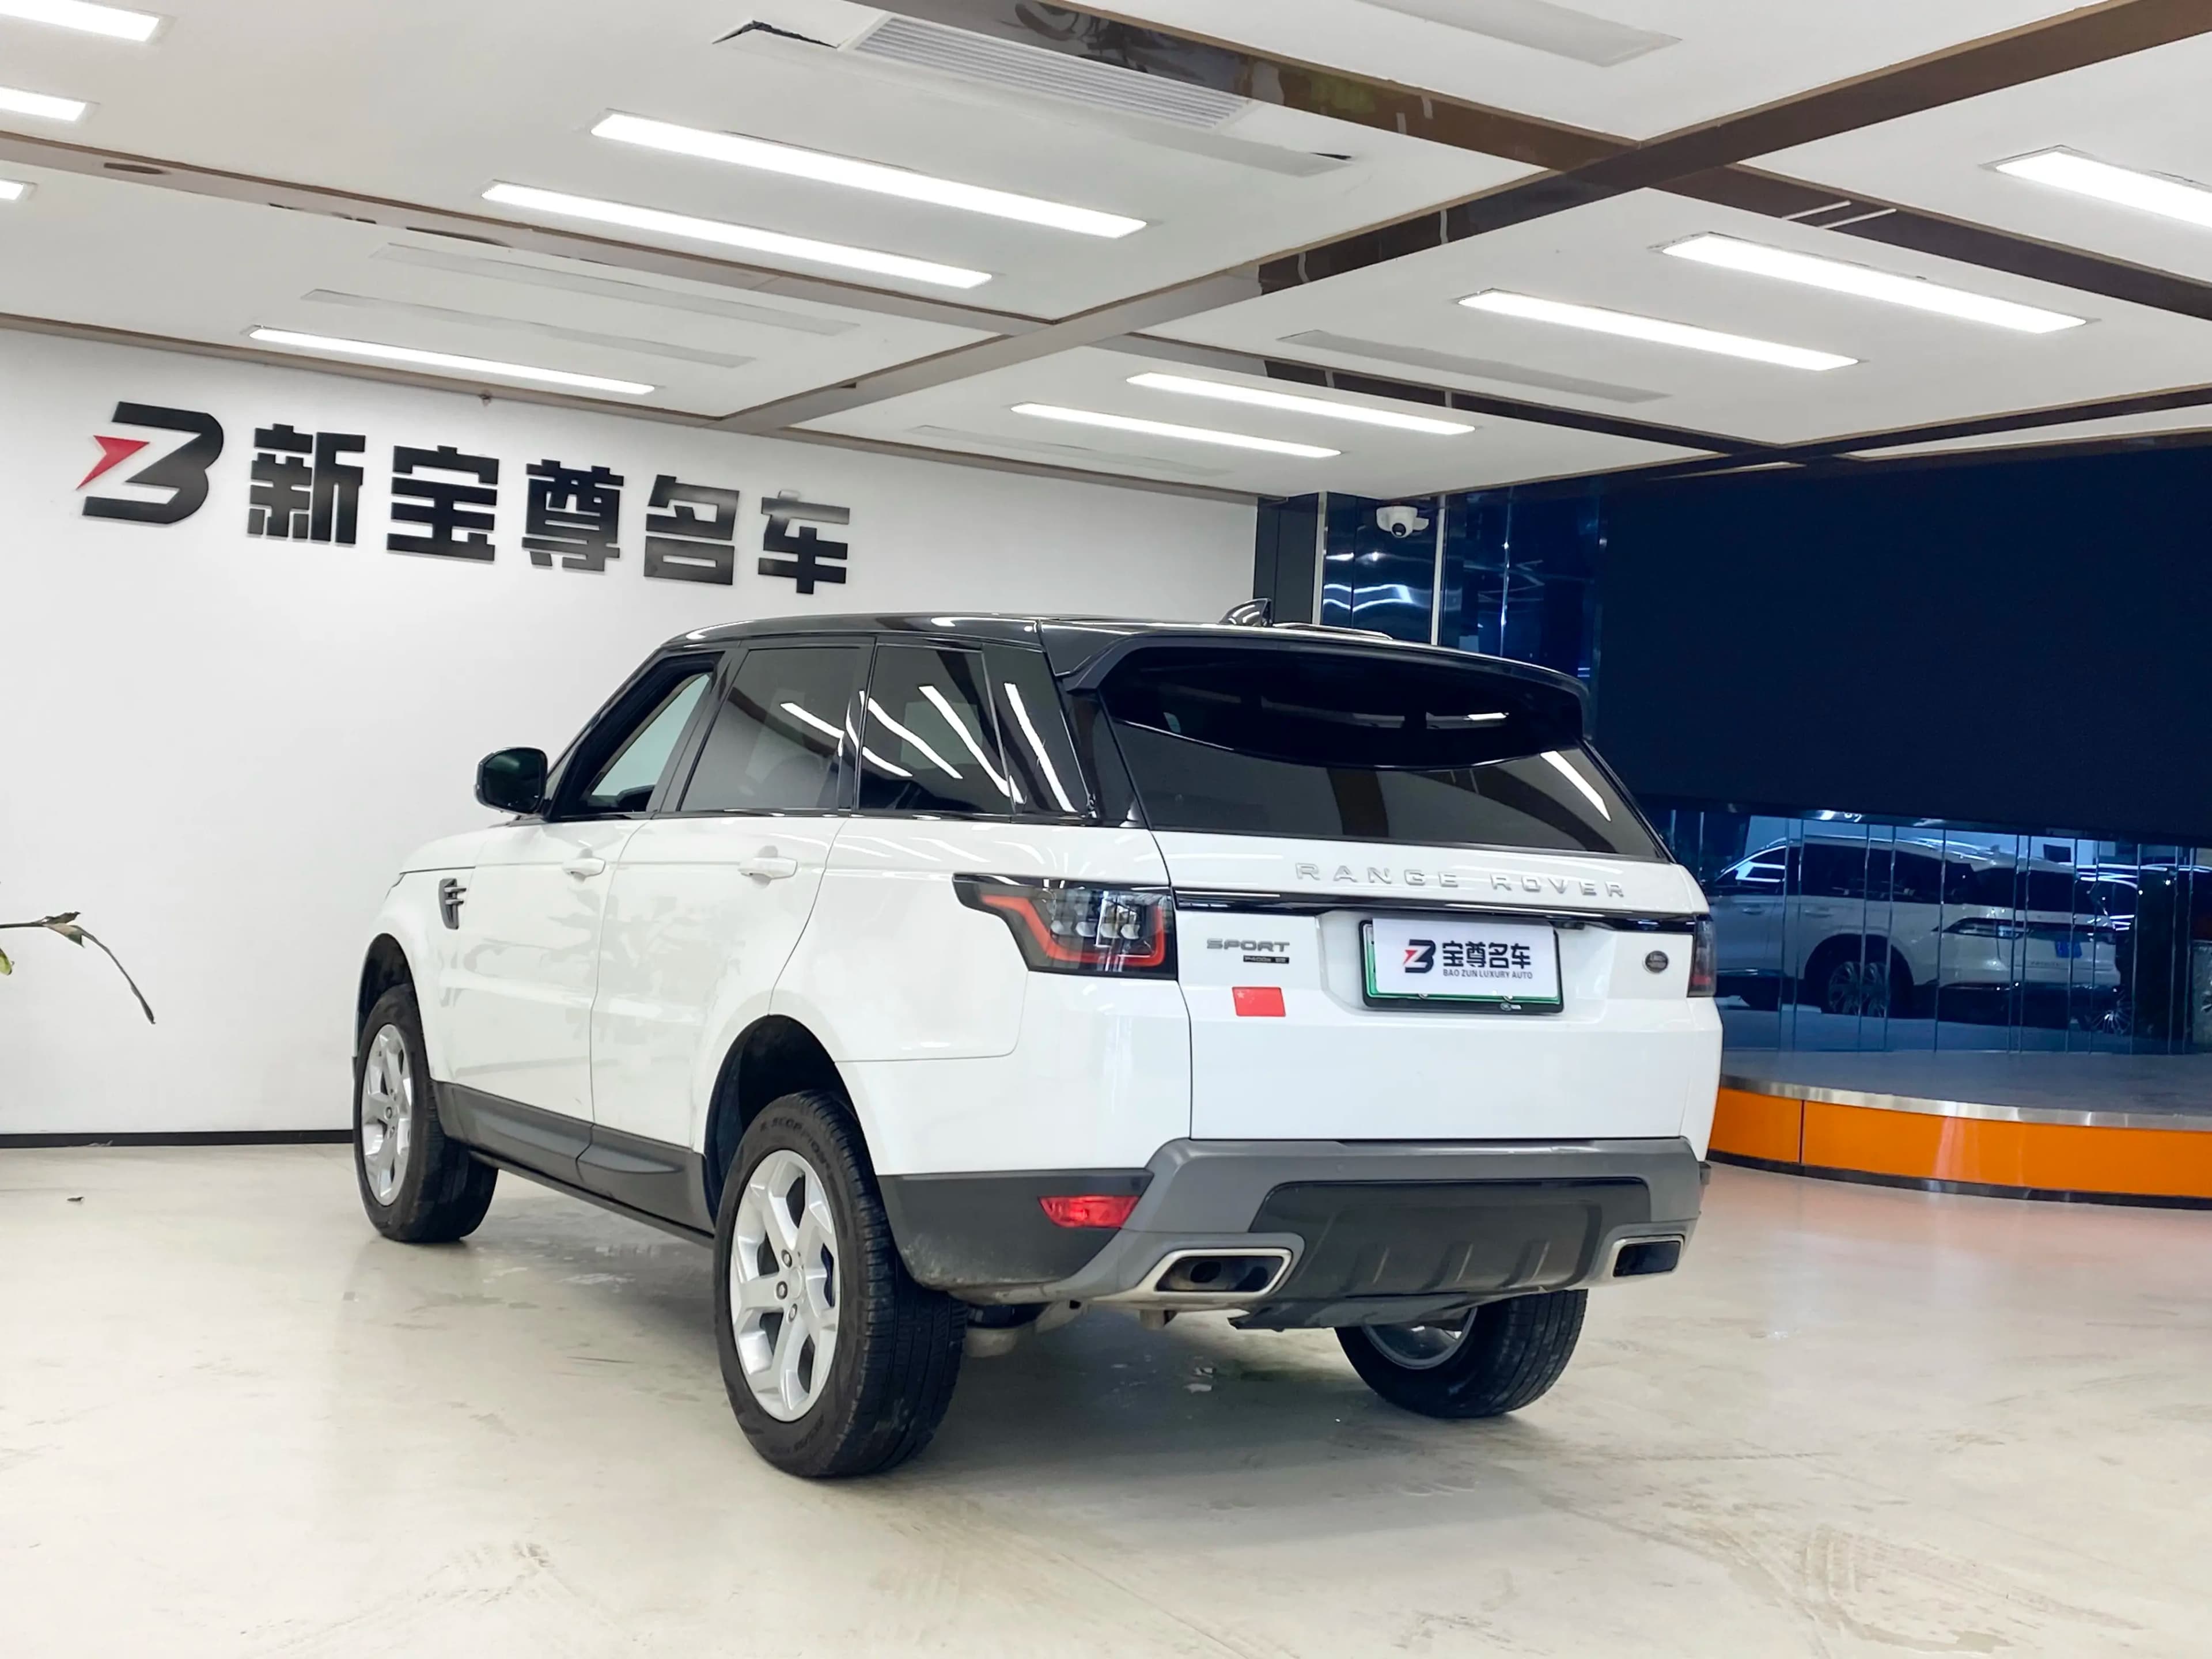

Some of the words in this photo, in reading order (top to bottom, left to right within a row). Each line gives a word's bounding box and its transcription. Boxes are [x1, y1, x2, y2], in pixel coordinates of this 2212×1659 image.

[247, 423, 850, 594] 新宝尊名车
[1296, 863, 1459, 888] RANGE
[1490, 873, 1624, 897] ROVER
[1207, 938, 1290, 952] SPORT
[1442, 940, 1531, 969] 宝尊名车
[1443, 969, 1460, 977] BAO
[1461, 969, 1478, 978] ZUN
[1479, 970, 1510, 979] LUXURY
[1512, 971, 1533, 979] AUTO
